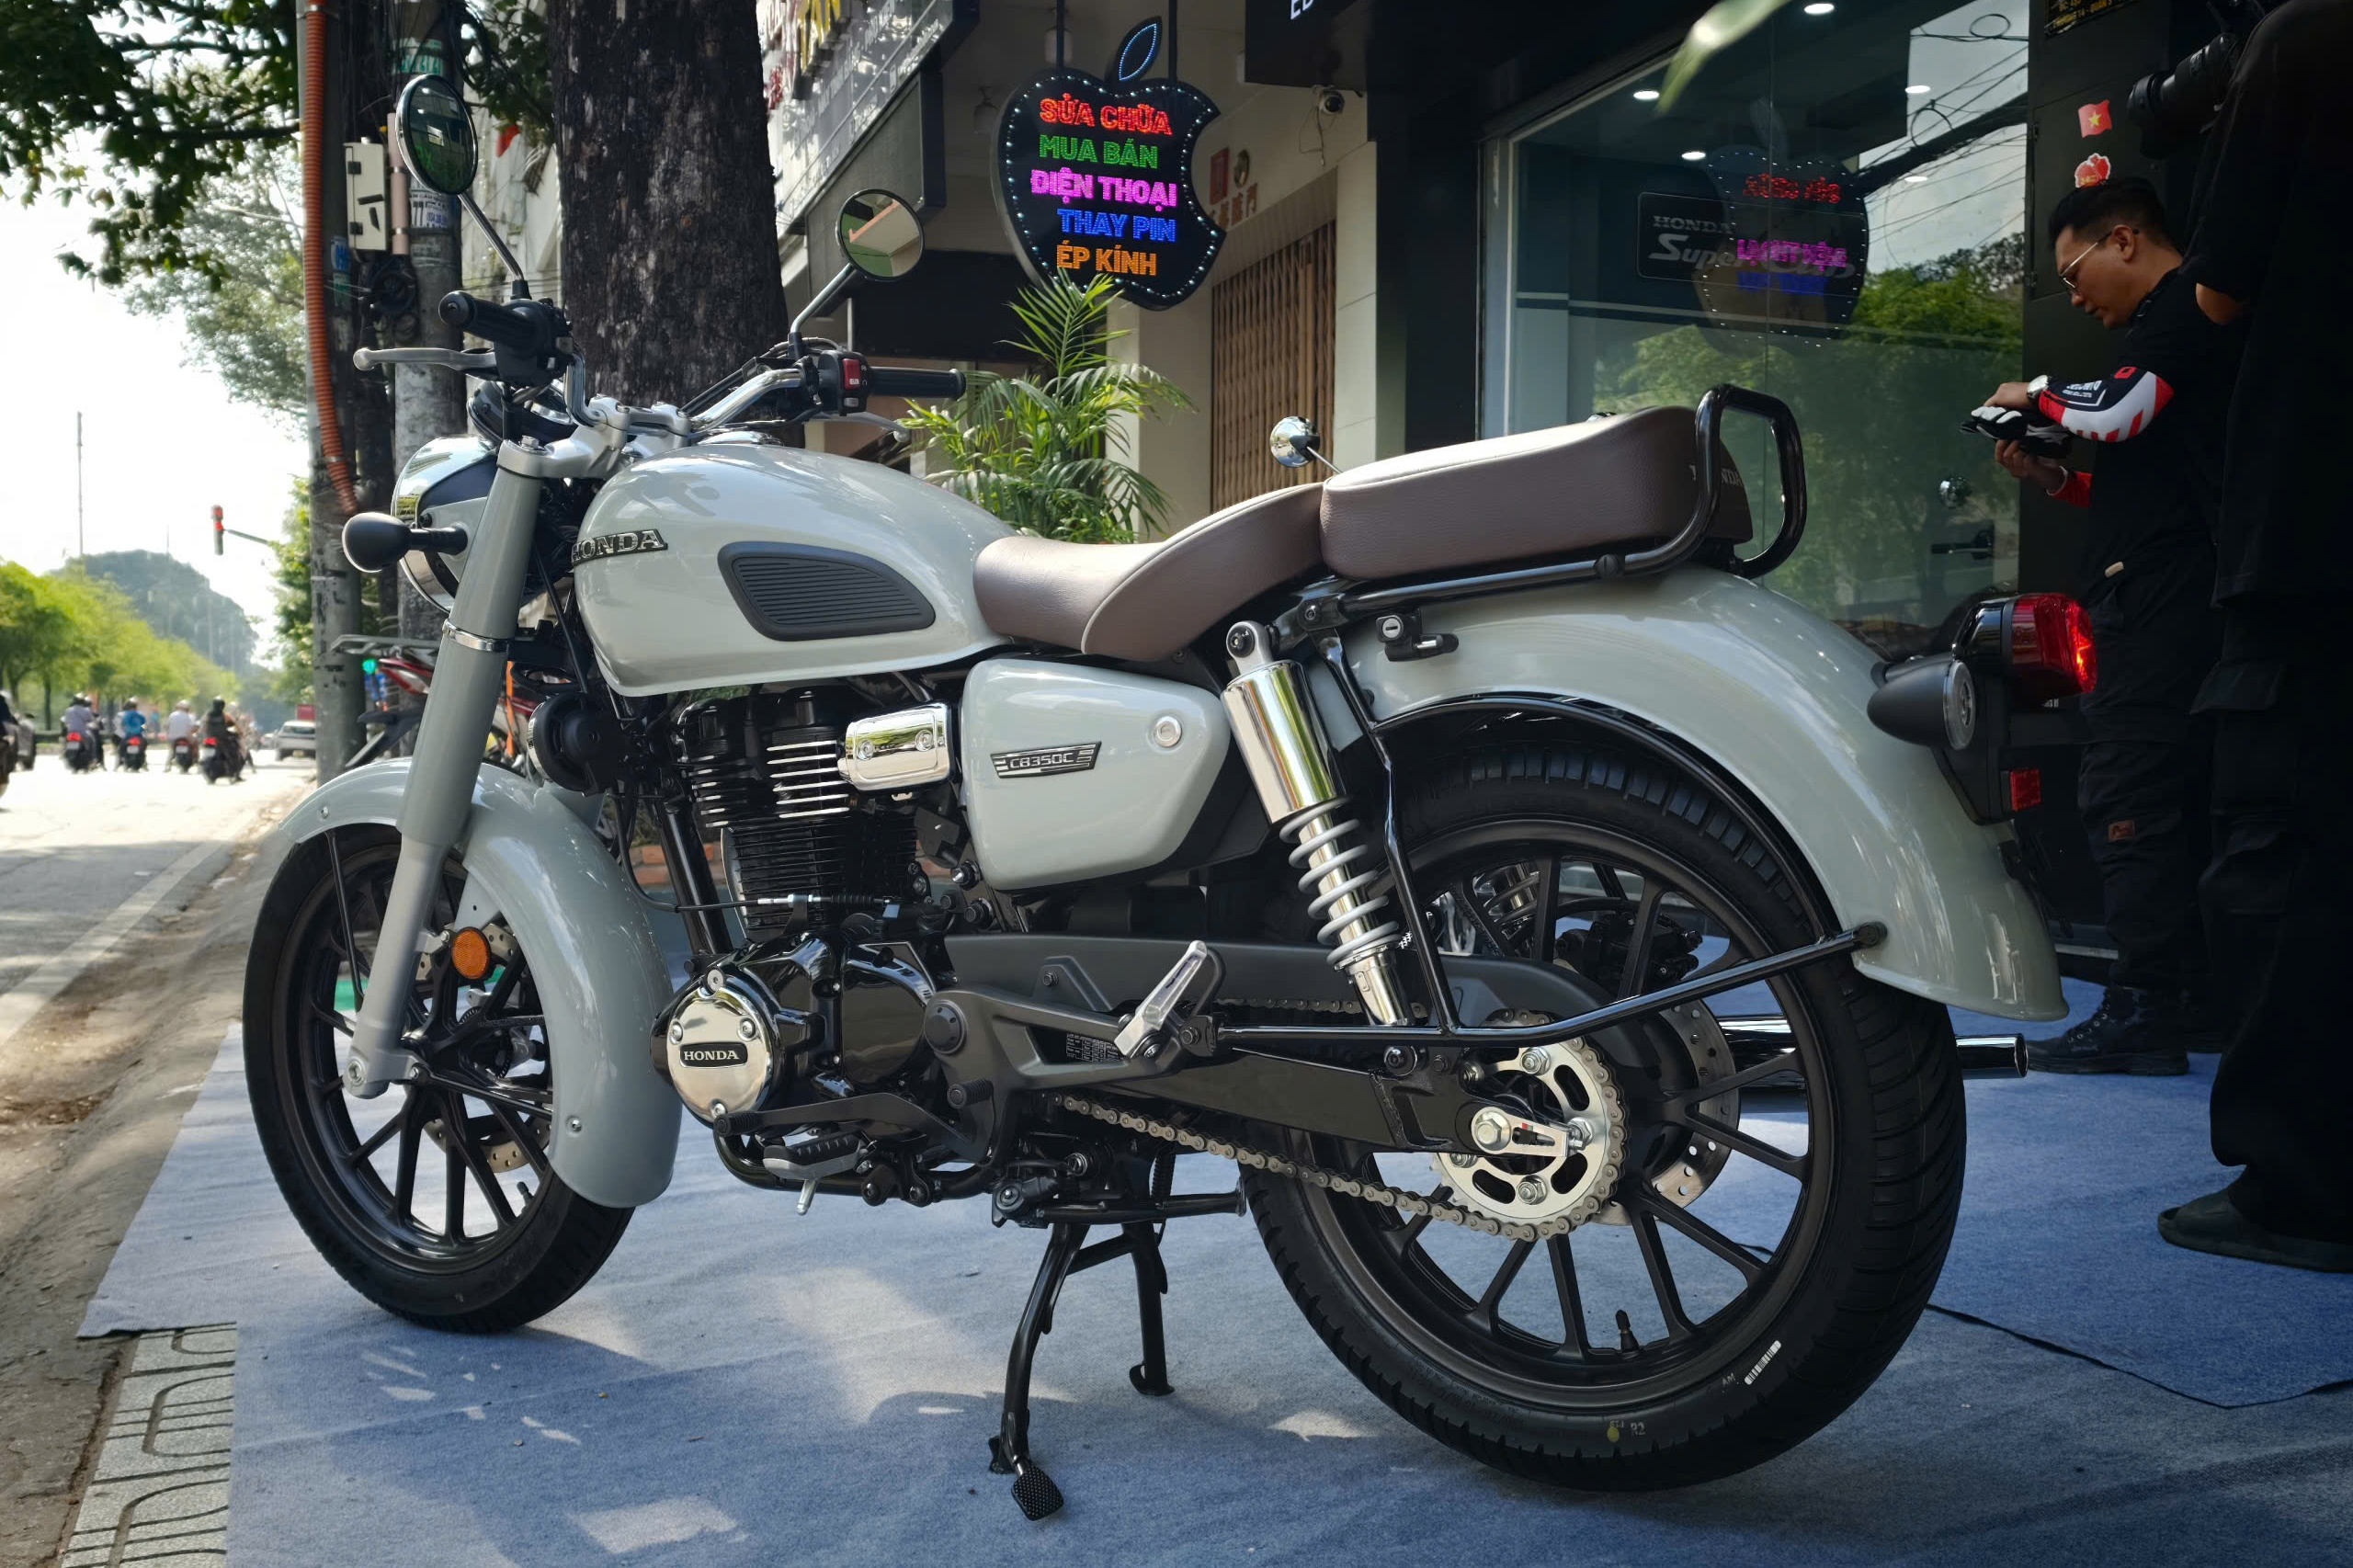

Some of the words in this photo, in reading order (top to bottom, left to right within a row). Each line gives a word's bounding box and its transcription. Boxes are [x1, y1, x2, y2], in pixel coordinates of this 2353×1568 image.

[1040, 93, 1095, 126] SỬA
[1100, 104, 1172, 135] CHỮA
[1039, 135, 1098, 164] MUA
[1103, 139, 1158, 169] BÁN
[1097, 176, 1177, 212] THOẠI
[1057, 209, 1129, 238] THAY
[1132, 215, 1176, 242] PIN
[1653, 216, 1733, 235] HONDA
[1056, 240, 1090, 270] ÉP
[1095, 244, 1157, 276] KÍNH
[1648, 233, 1745, 270] Super
[571, 529, 665, 562] HONDA
[1010, 753, 1074, 768] CB350C
[684, 1050, 739, 1061] HONDA
